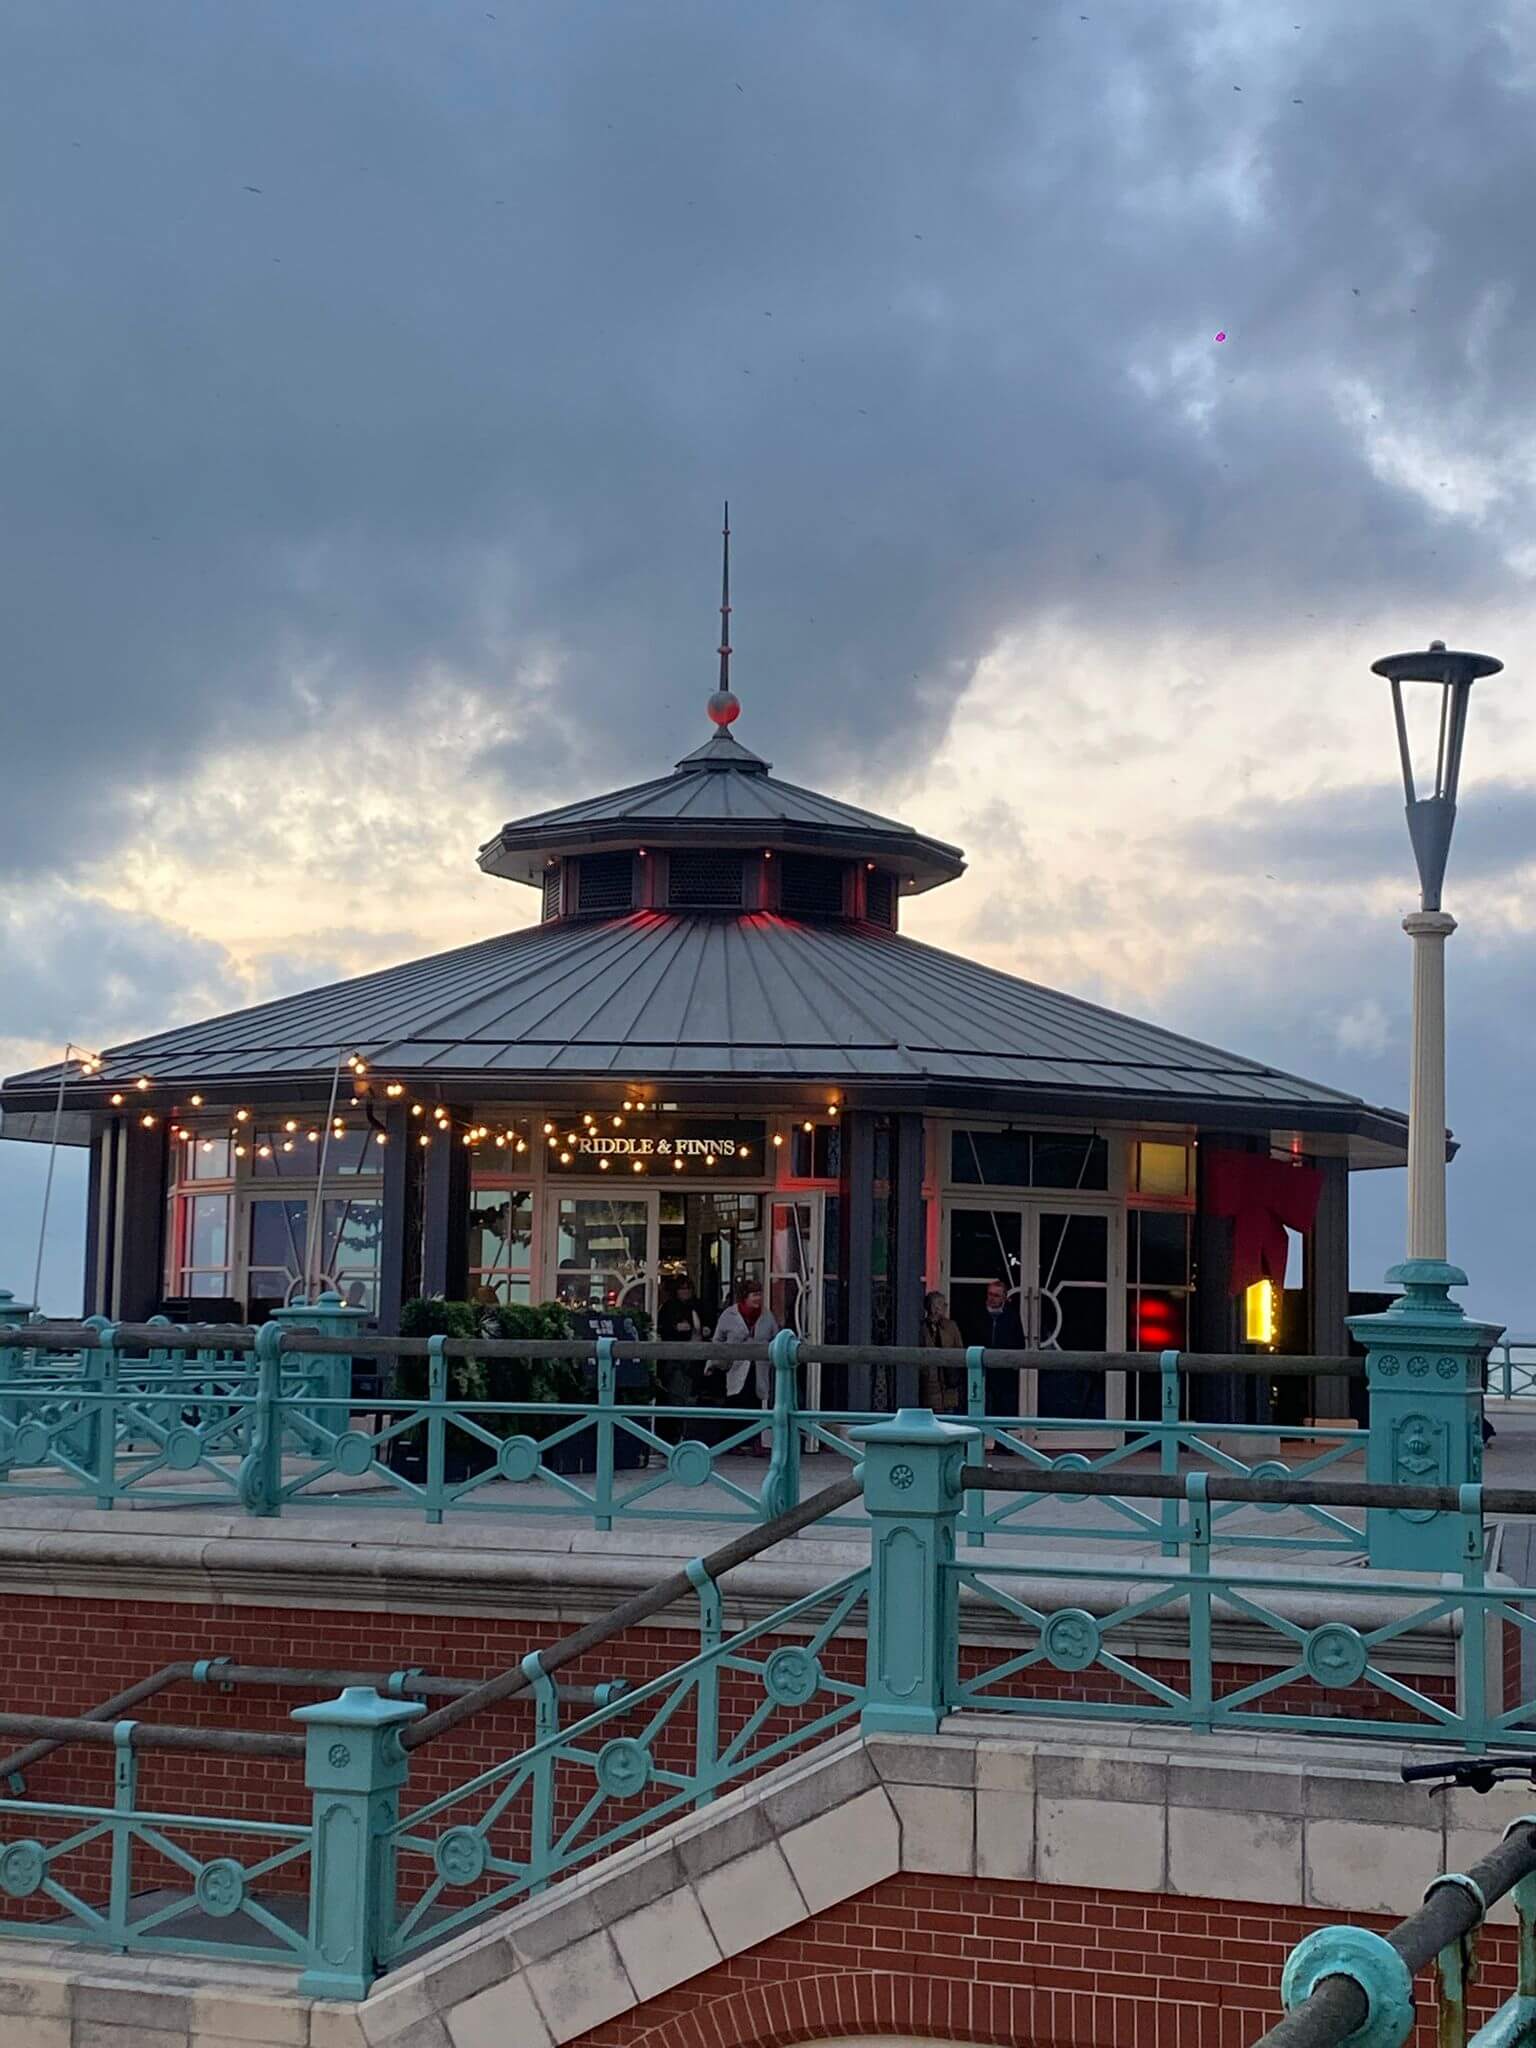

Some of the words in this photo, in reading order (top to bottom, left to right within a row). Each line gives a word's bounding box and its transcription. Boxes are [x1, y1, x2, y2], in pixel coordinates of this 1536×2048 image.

[579, 1138, 654, 1154] RIDDLE
[656, 1139, 672, 1155] &
[675, 1139, 735, 1156] FINNS
